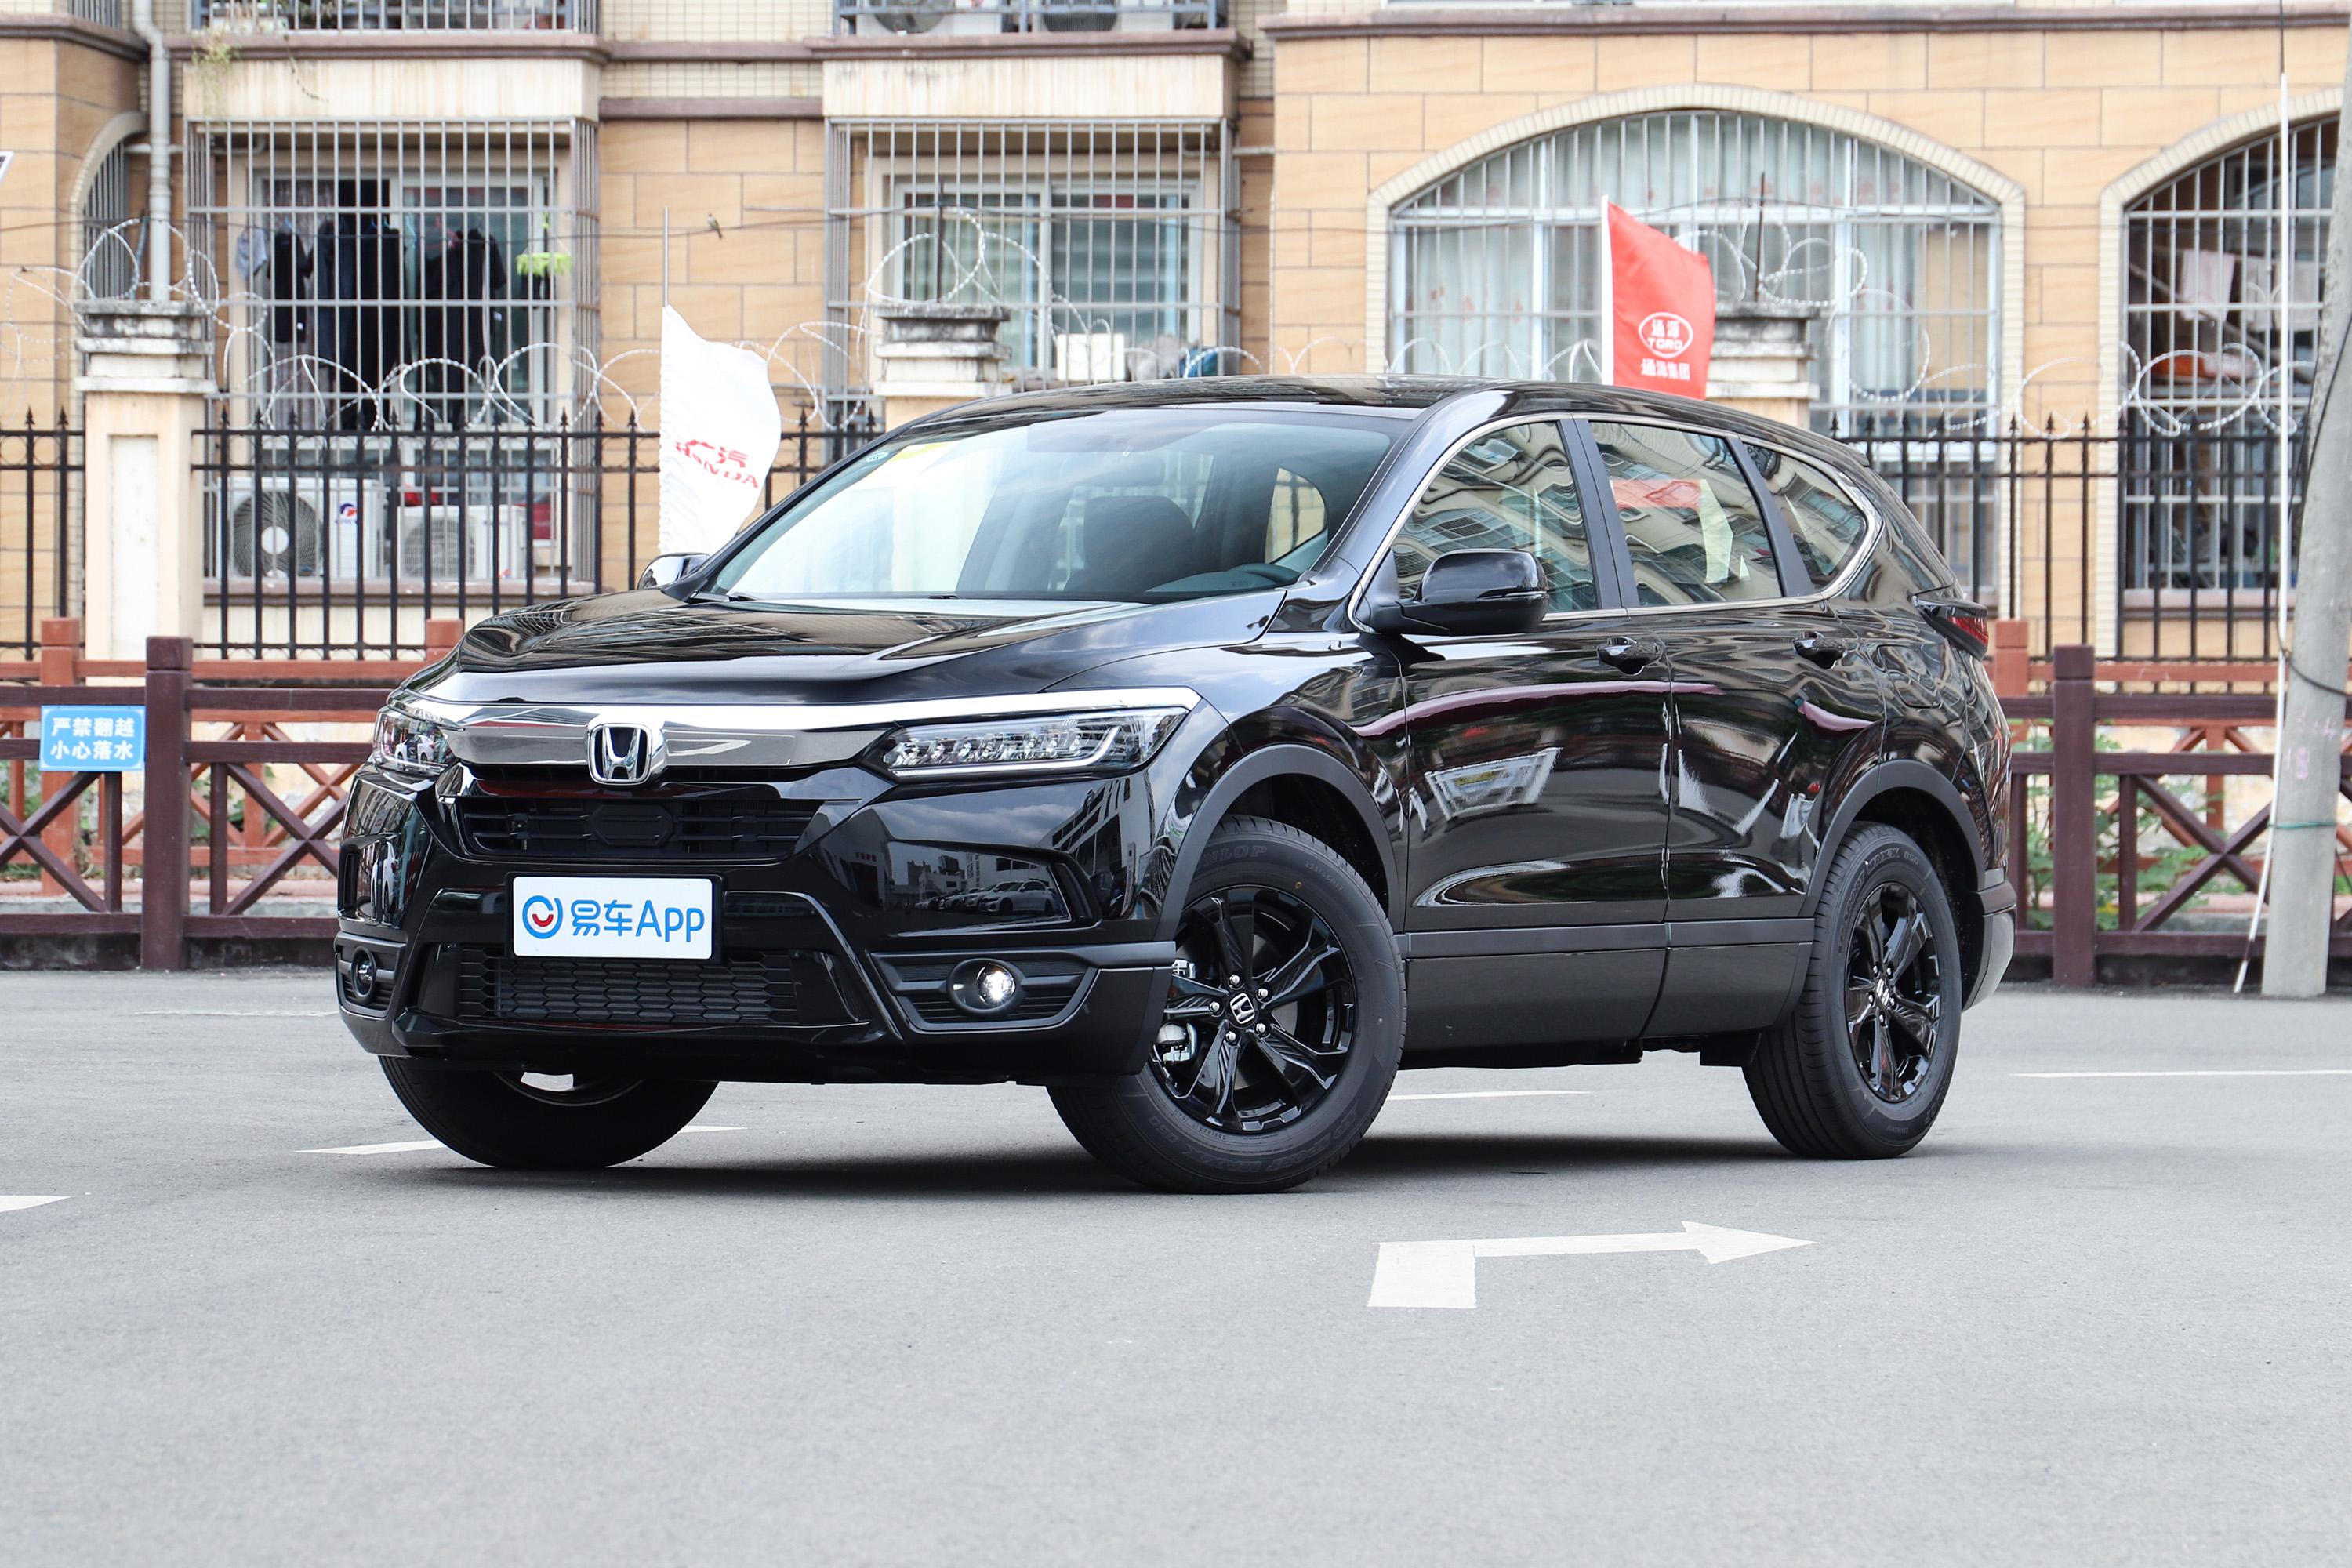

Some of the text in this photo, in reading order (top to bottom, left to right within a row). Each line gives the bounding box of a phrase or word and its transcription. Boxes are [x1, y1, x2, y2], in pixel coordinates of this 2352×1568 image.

[1641, 358, 1690, 381] 通源集团
[51, 717, 135, 737] 严禁翻越
[50, 740, 133, 760] 小心落水
[571, 900, 705, 942] 易车App
